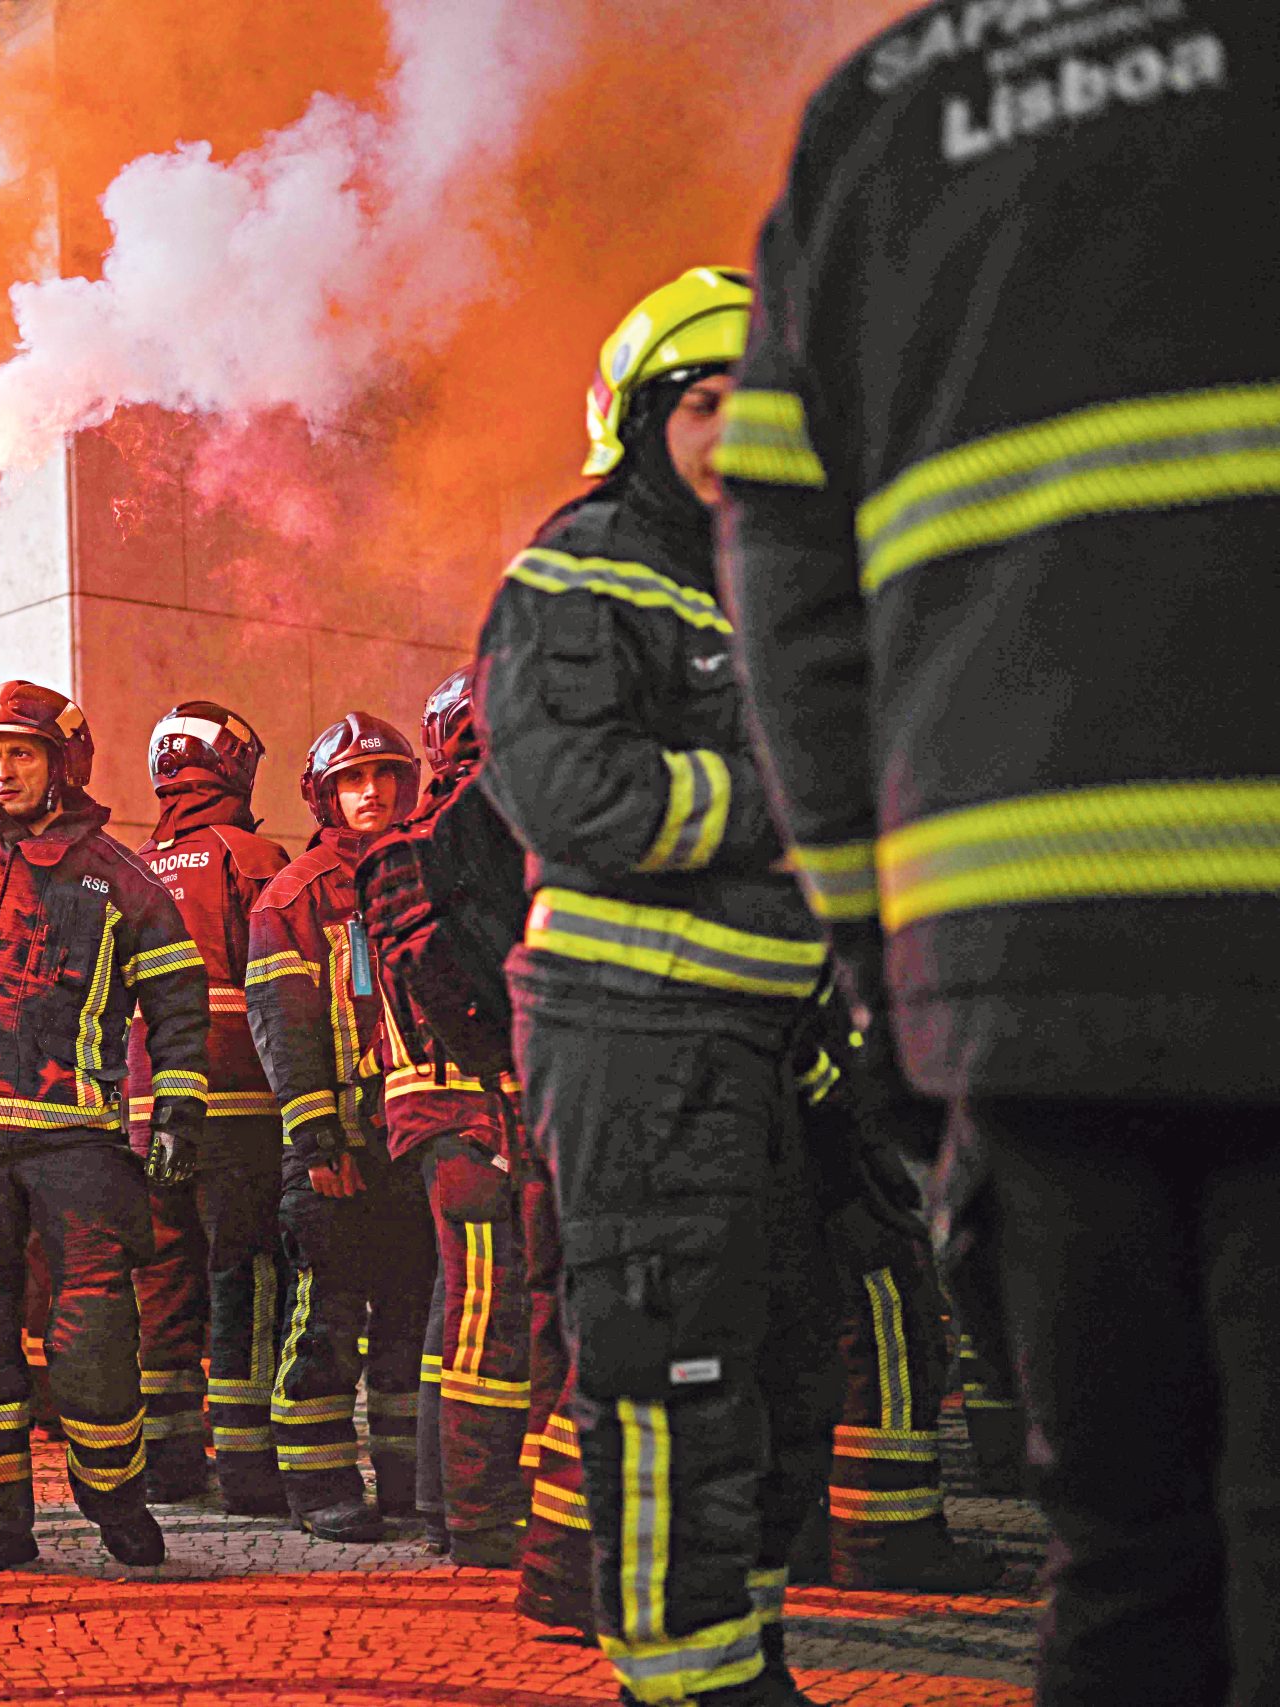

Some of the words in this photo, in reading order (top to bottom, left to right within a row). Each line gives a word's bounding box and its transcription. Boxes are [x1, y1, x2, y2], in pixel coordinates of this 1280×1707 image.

[942, 35, 1224, 160] Lisboa
[360, 738, 381, 749] RSB
[146, 851, 210, 875] ADORES
[81, 875, 110, 894] RSB
